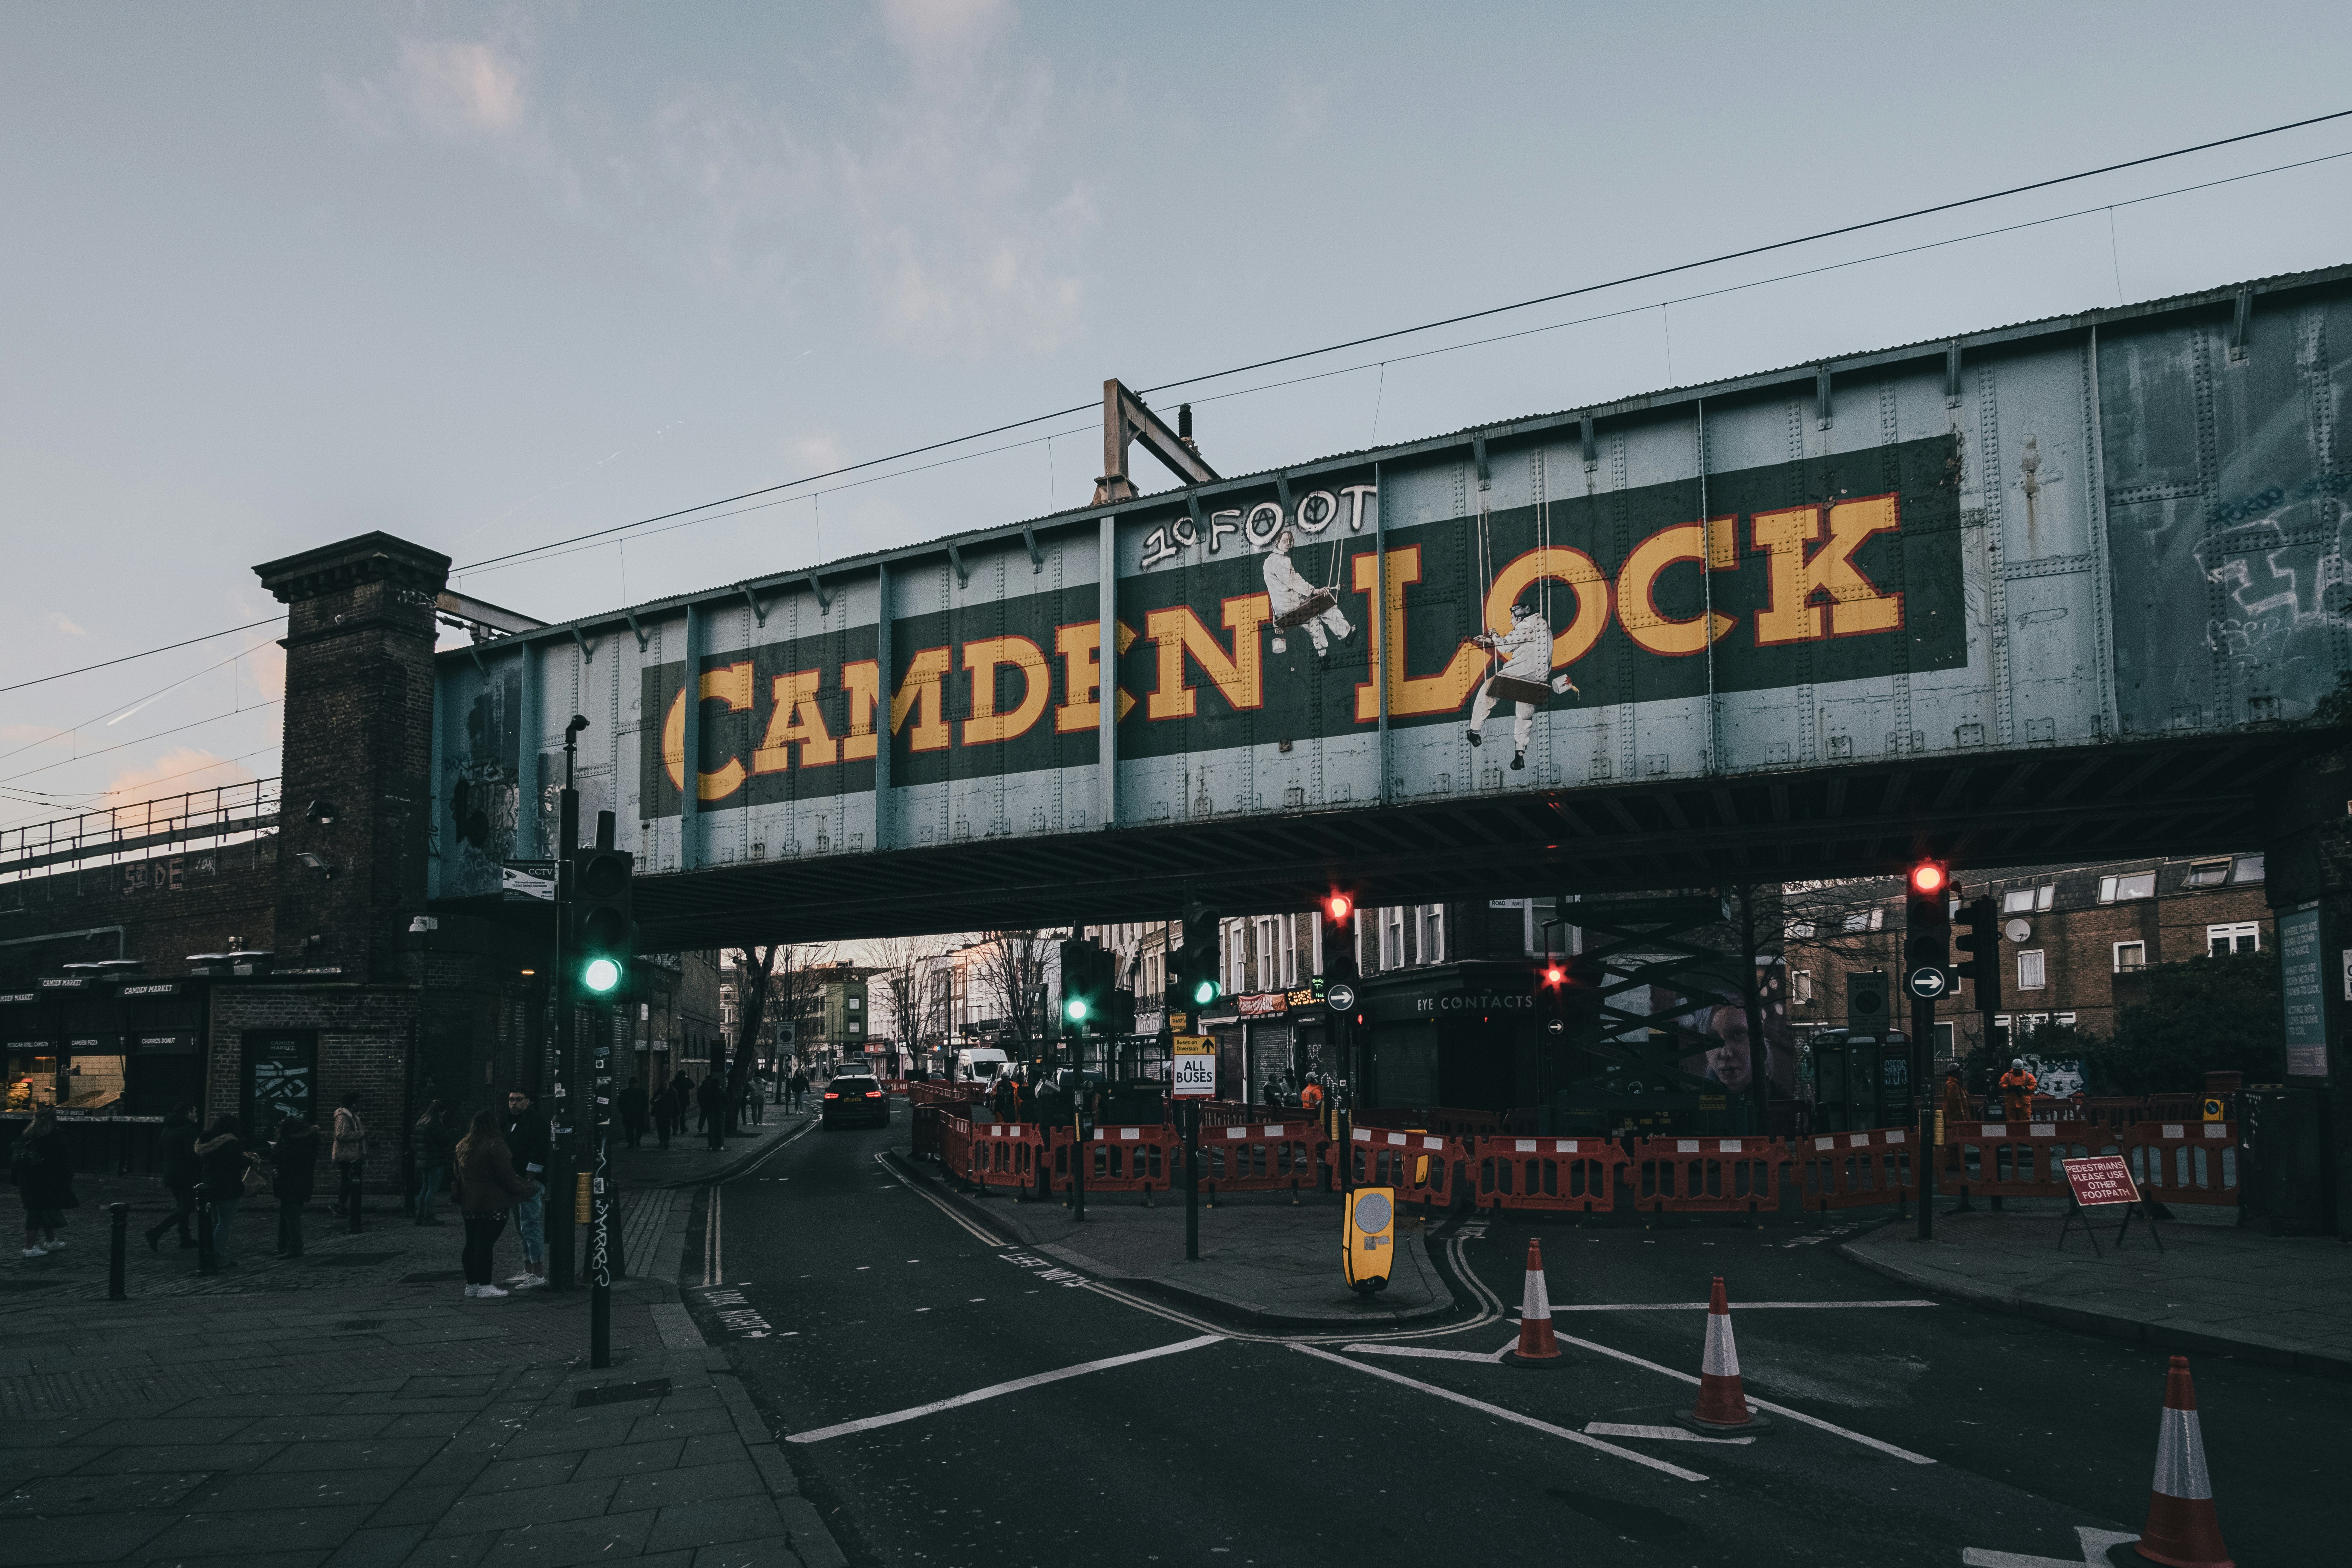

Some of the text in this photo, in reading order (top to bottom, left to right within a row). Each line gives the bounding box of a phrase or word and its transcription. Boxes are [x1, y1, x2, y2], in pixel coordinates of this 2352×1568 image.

[662, 491, 1905, 802] CAMDEN LOCK
[124, 985, 173, 995] CAMDEN MARKET
[1262, 997, 1274, 1011] SALE
[1418, 995, 1533, 1011] EYE CONTACTS
[1184, 1060, 1205, 1071] ALL
[1176, 1072, 1213, 1083] BUSES
[2066, 1161, 2124, 1173] PEDESTRIANS
[2072, 1170, 2125, 1182] PLEASE USE
[2088, 1180, 2118, 1190] OTHER
[2082, 1188, 2130, 1199] FOOTPATH
